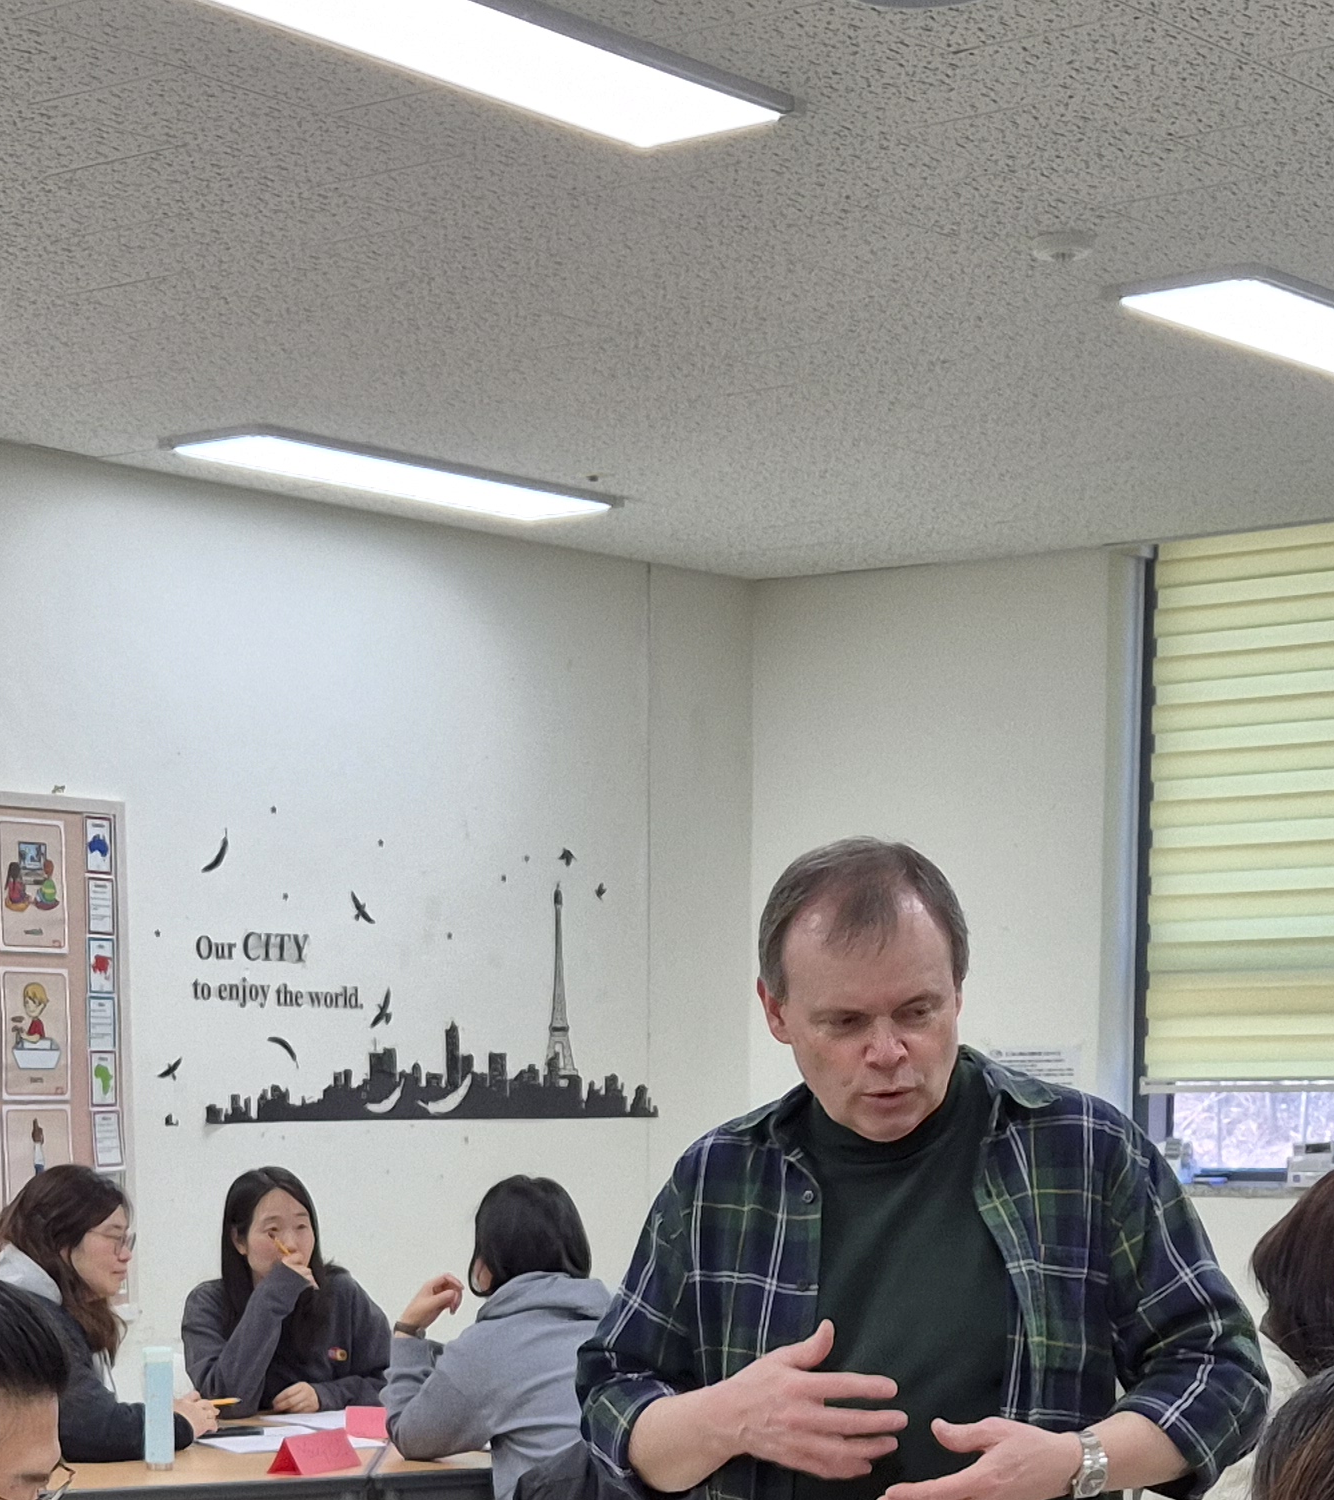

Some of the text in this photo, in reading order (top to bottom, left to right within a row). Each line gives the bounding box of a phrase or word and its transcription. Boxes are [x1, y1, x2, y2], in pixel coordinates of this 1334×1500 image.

[195, 931, 309, 963] Our CITY
[192, 977, 364, 1010] to enjoy the world.
